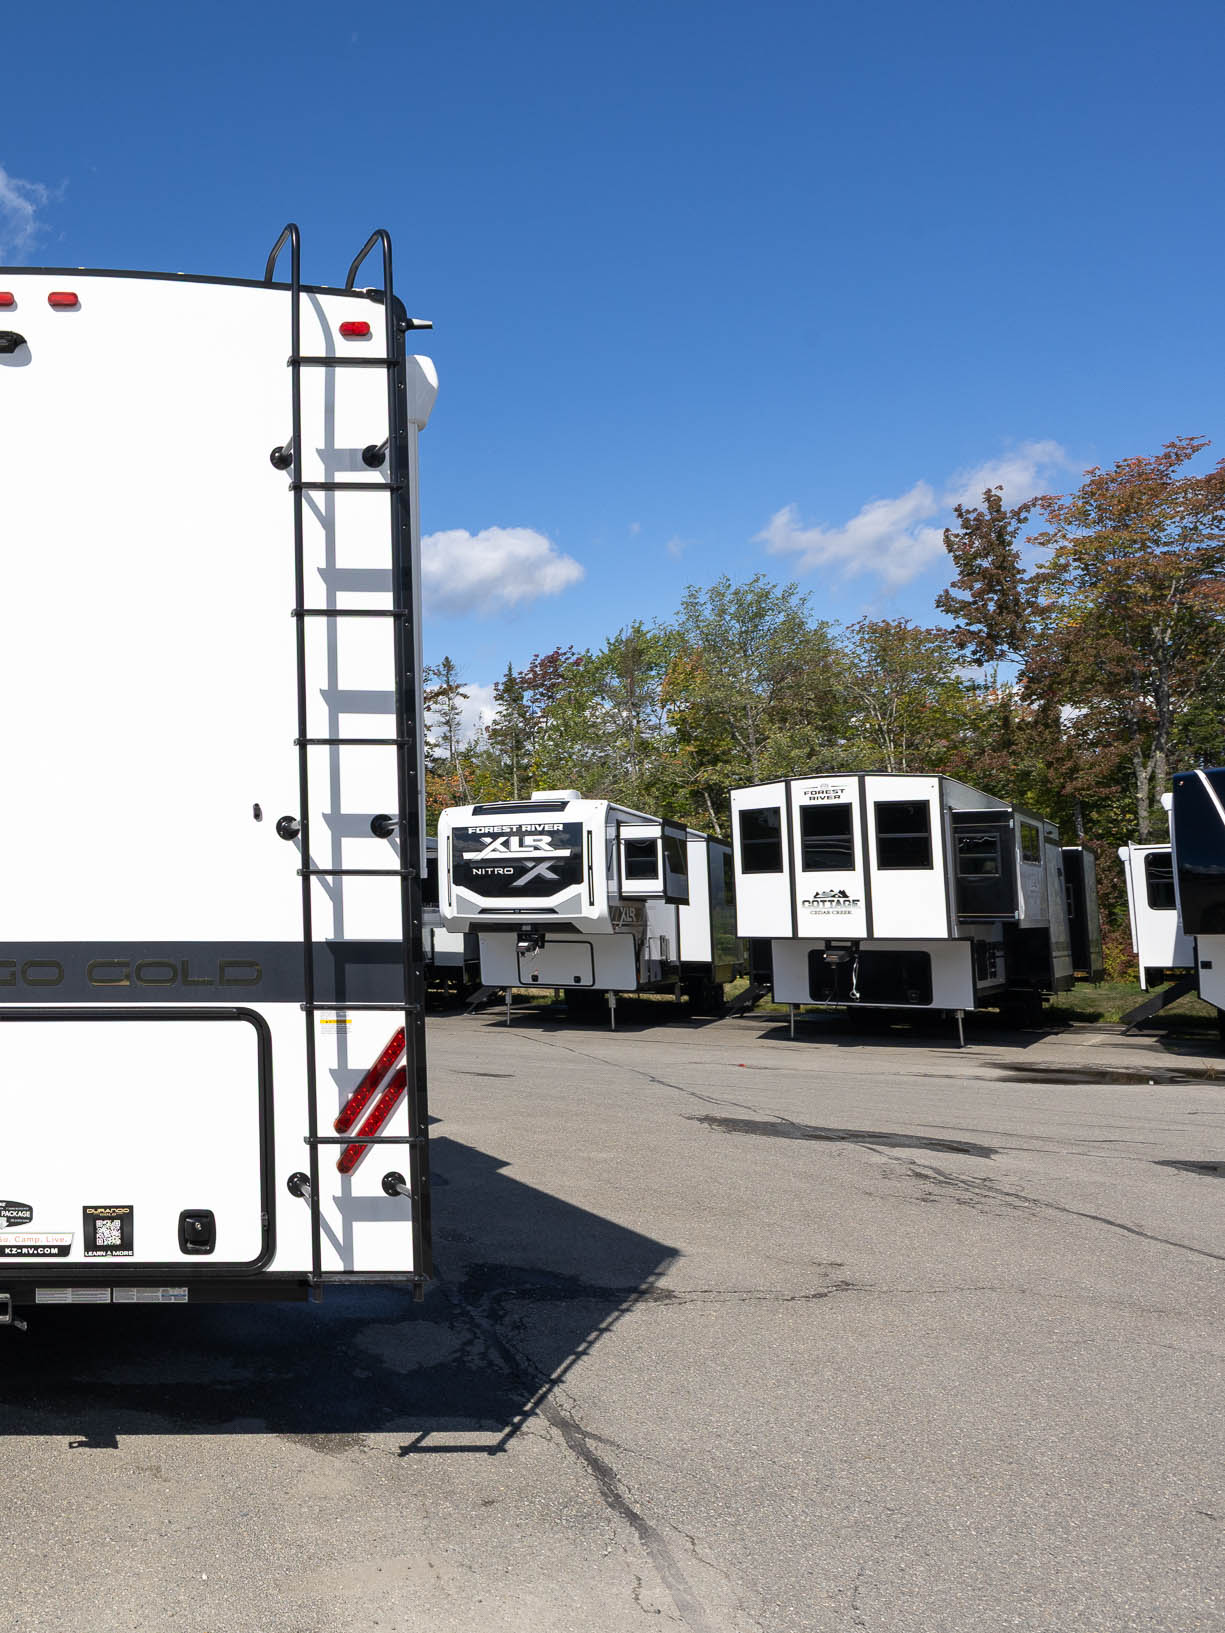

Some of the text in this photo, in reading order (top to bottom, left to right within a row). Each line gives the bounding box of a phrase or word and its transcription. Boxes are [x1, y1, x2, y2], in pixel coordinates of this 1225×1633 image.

[803, 788, 846, 796] FOREST
[467, 823, 564, 834] FOREST RIVER
[472, 835, 555, 861] XLR
[472, 867, 514, 875] NITRO
[802, 899, 861, 909] COTTAGE
[86, 959, 263, 987] GOLD
